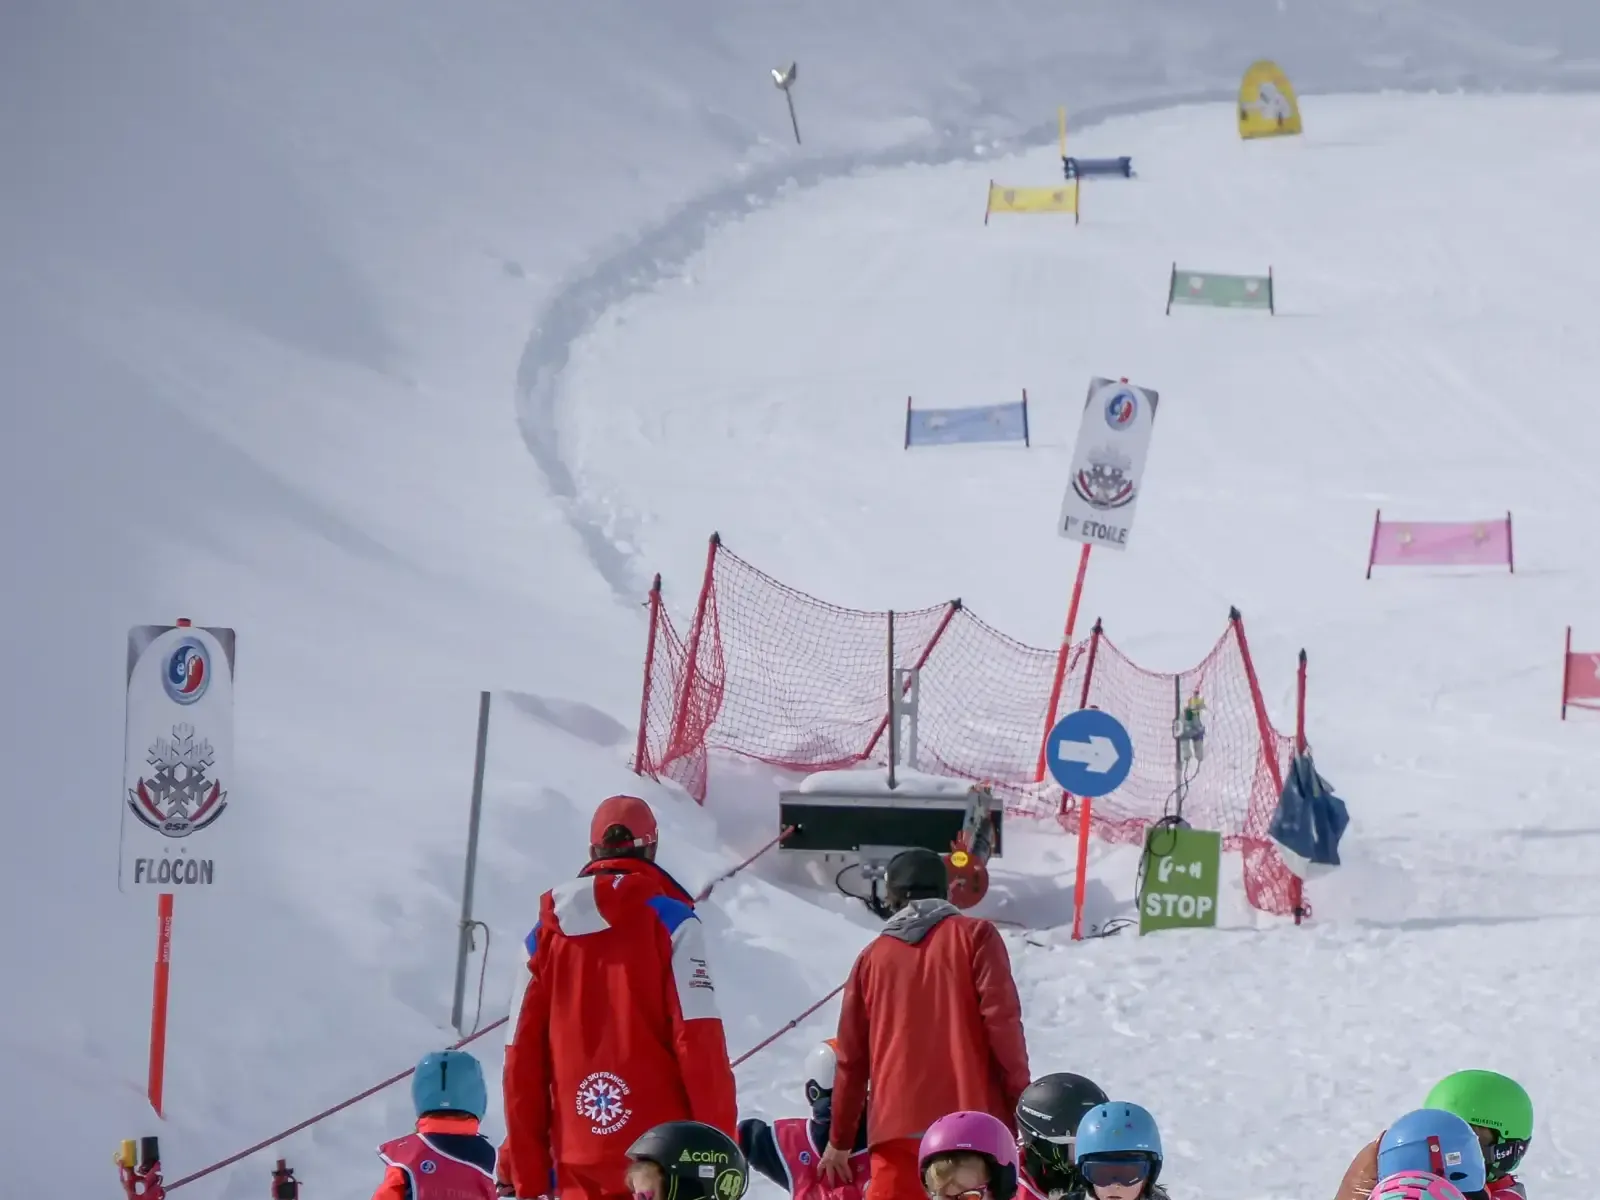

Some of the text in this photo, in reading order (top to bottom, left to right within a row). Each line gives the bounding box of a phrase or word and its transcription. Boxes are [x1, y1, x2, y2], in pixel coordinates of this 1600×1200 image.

[134, 858, 213, 884] FLOCON
[1145, 892, 1213, 919] STOP
[587, 1072, 599, 1082] SKI
[591, 1108, 633, 1135] CAUTERETS
[692, 1149, 729, 1164] cairn
[719, 1173, 741, 1197] 48
